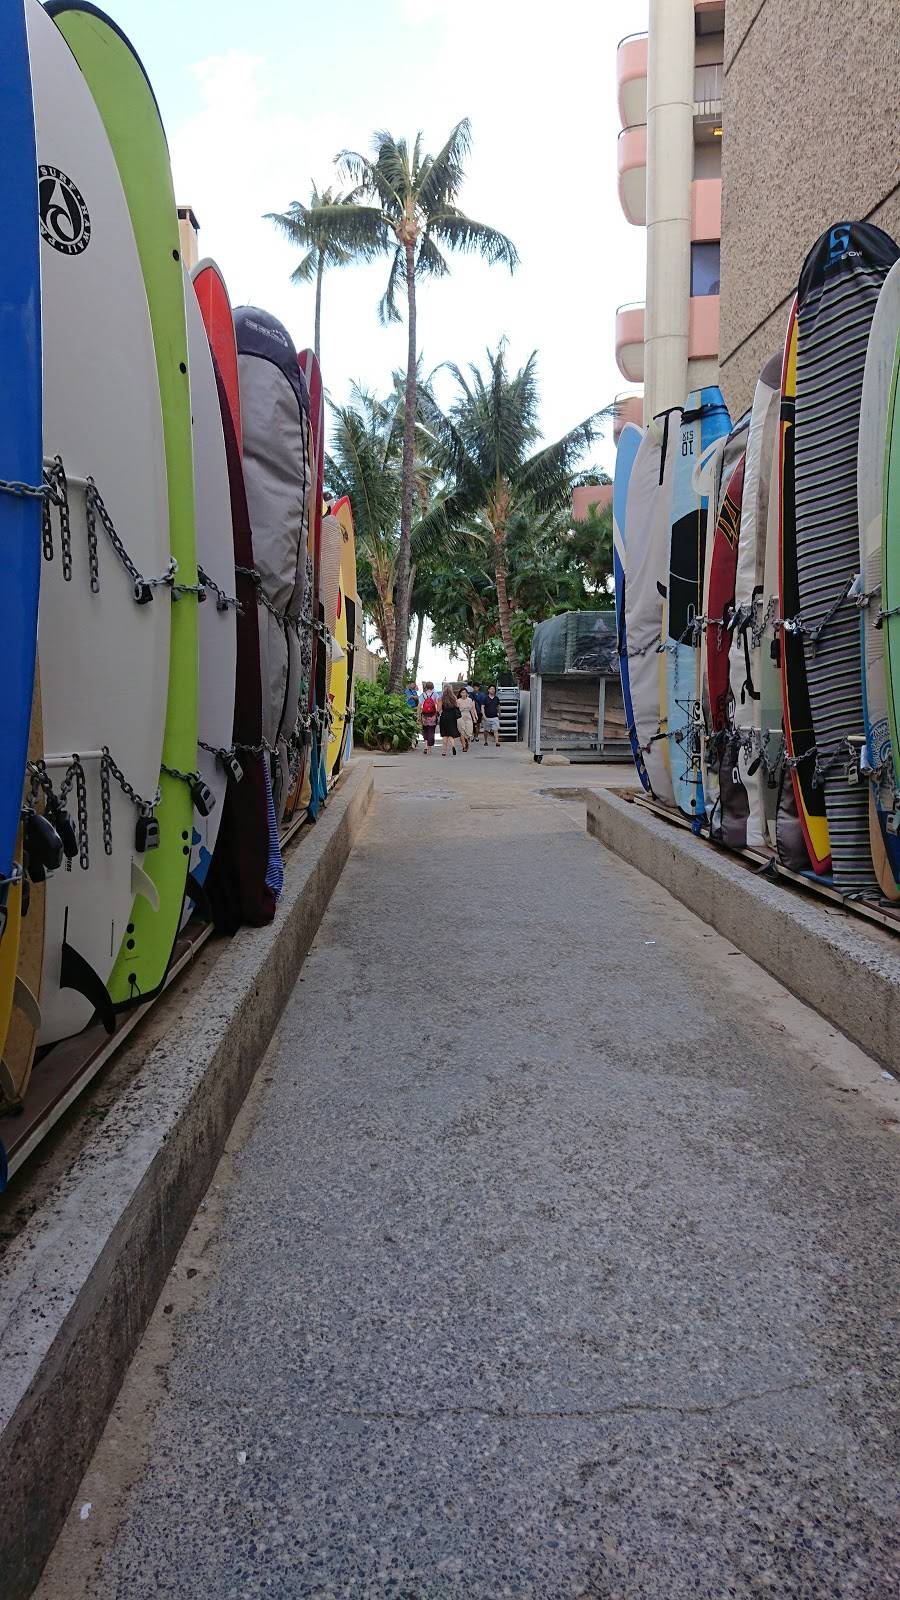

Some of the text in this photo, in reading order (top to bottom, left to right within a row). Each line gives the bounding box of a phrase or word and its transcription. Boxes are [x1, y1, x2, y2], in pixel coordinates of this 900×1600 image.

[40, 166, 77, 191] SURF
[68, 205, 91, 254] HAWAII
[682, 430, 694, 442] SIX
[682, 440, 694, 457] 10
